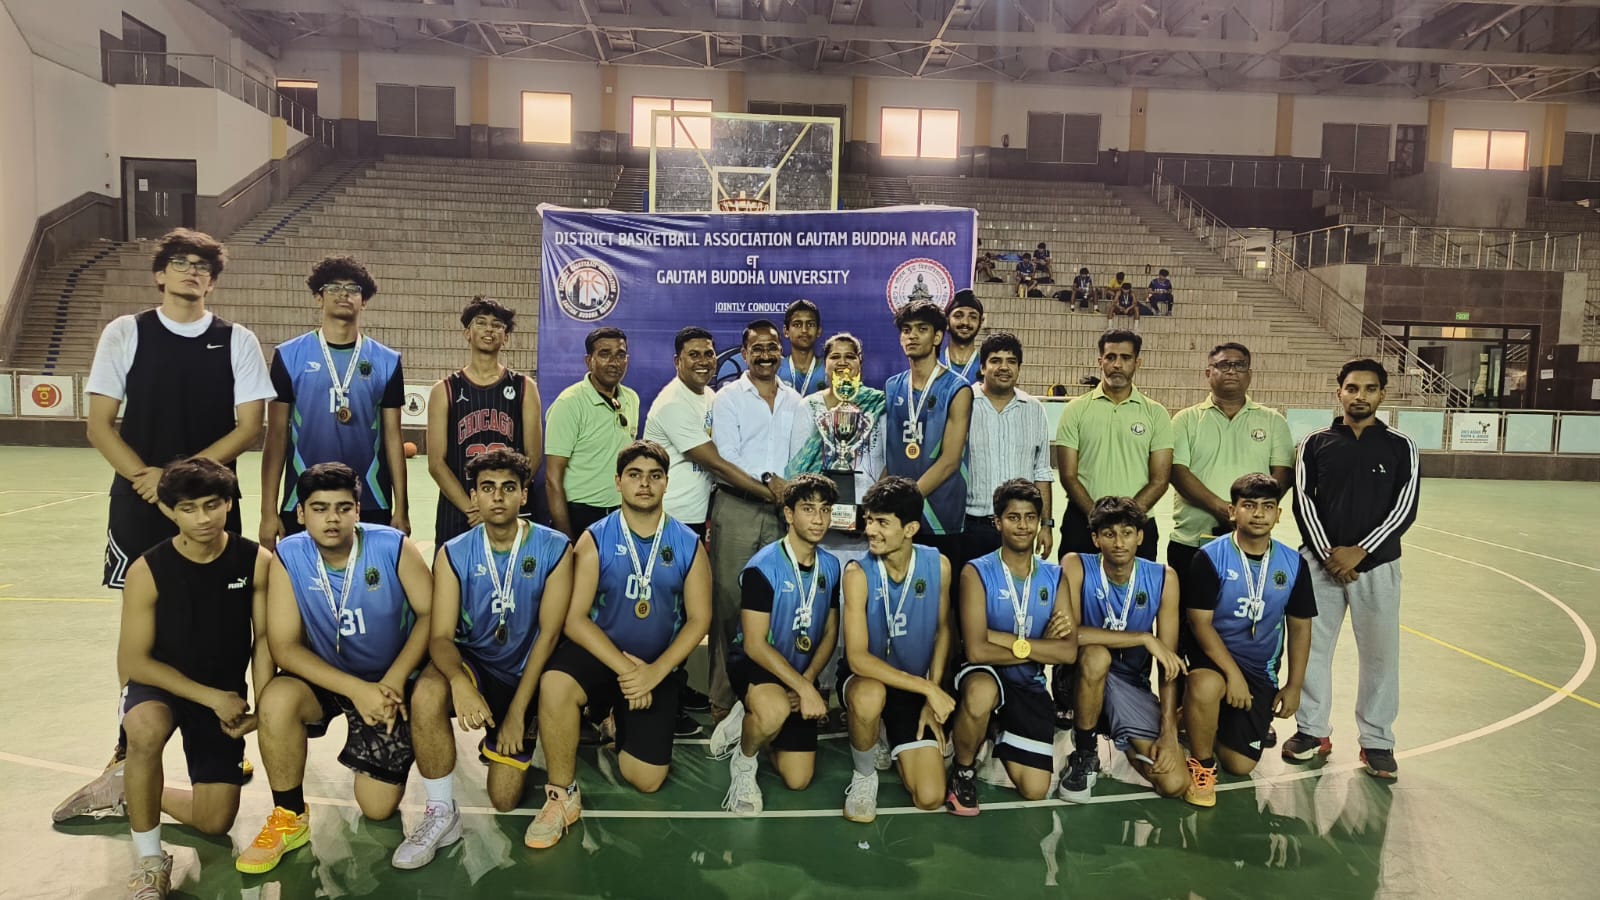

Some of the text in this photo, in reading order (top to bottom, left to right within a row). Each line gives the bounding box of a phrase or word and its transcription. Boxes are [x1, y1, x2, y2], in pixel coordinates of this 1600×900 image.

[555, 231, 956, 246] DISTRICT BASKETBALL ASSOCIATION GAUTAM BUDDHA NAGAR
[656, 270, 850, 284] GAUTAM BUDDHA UNIVERSITY
[715, 302, 746, 313] JOINTLY
[457, 408, 514, 446] CHICAGO
[902, 420, 924, 445] 24
[339, 607, 367, 637] 31
